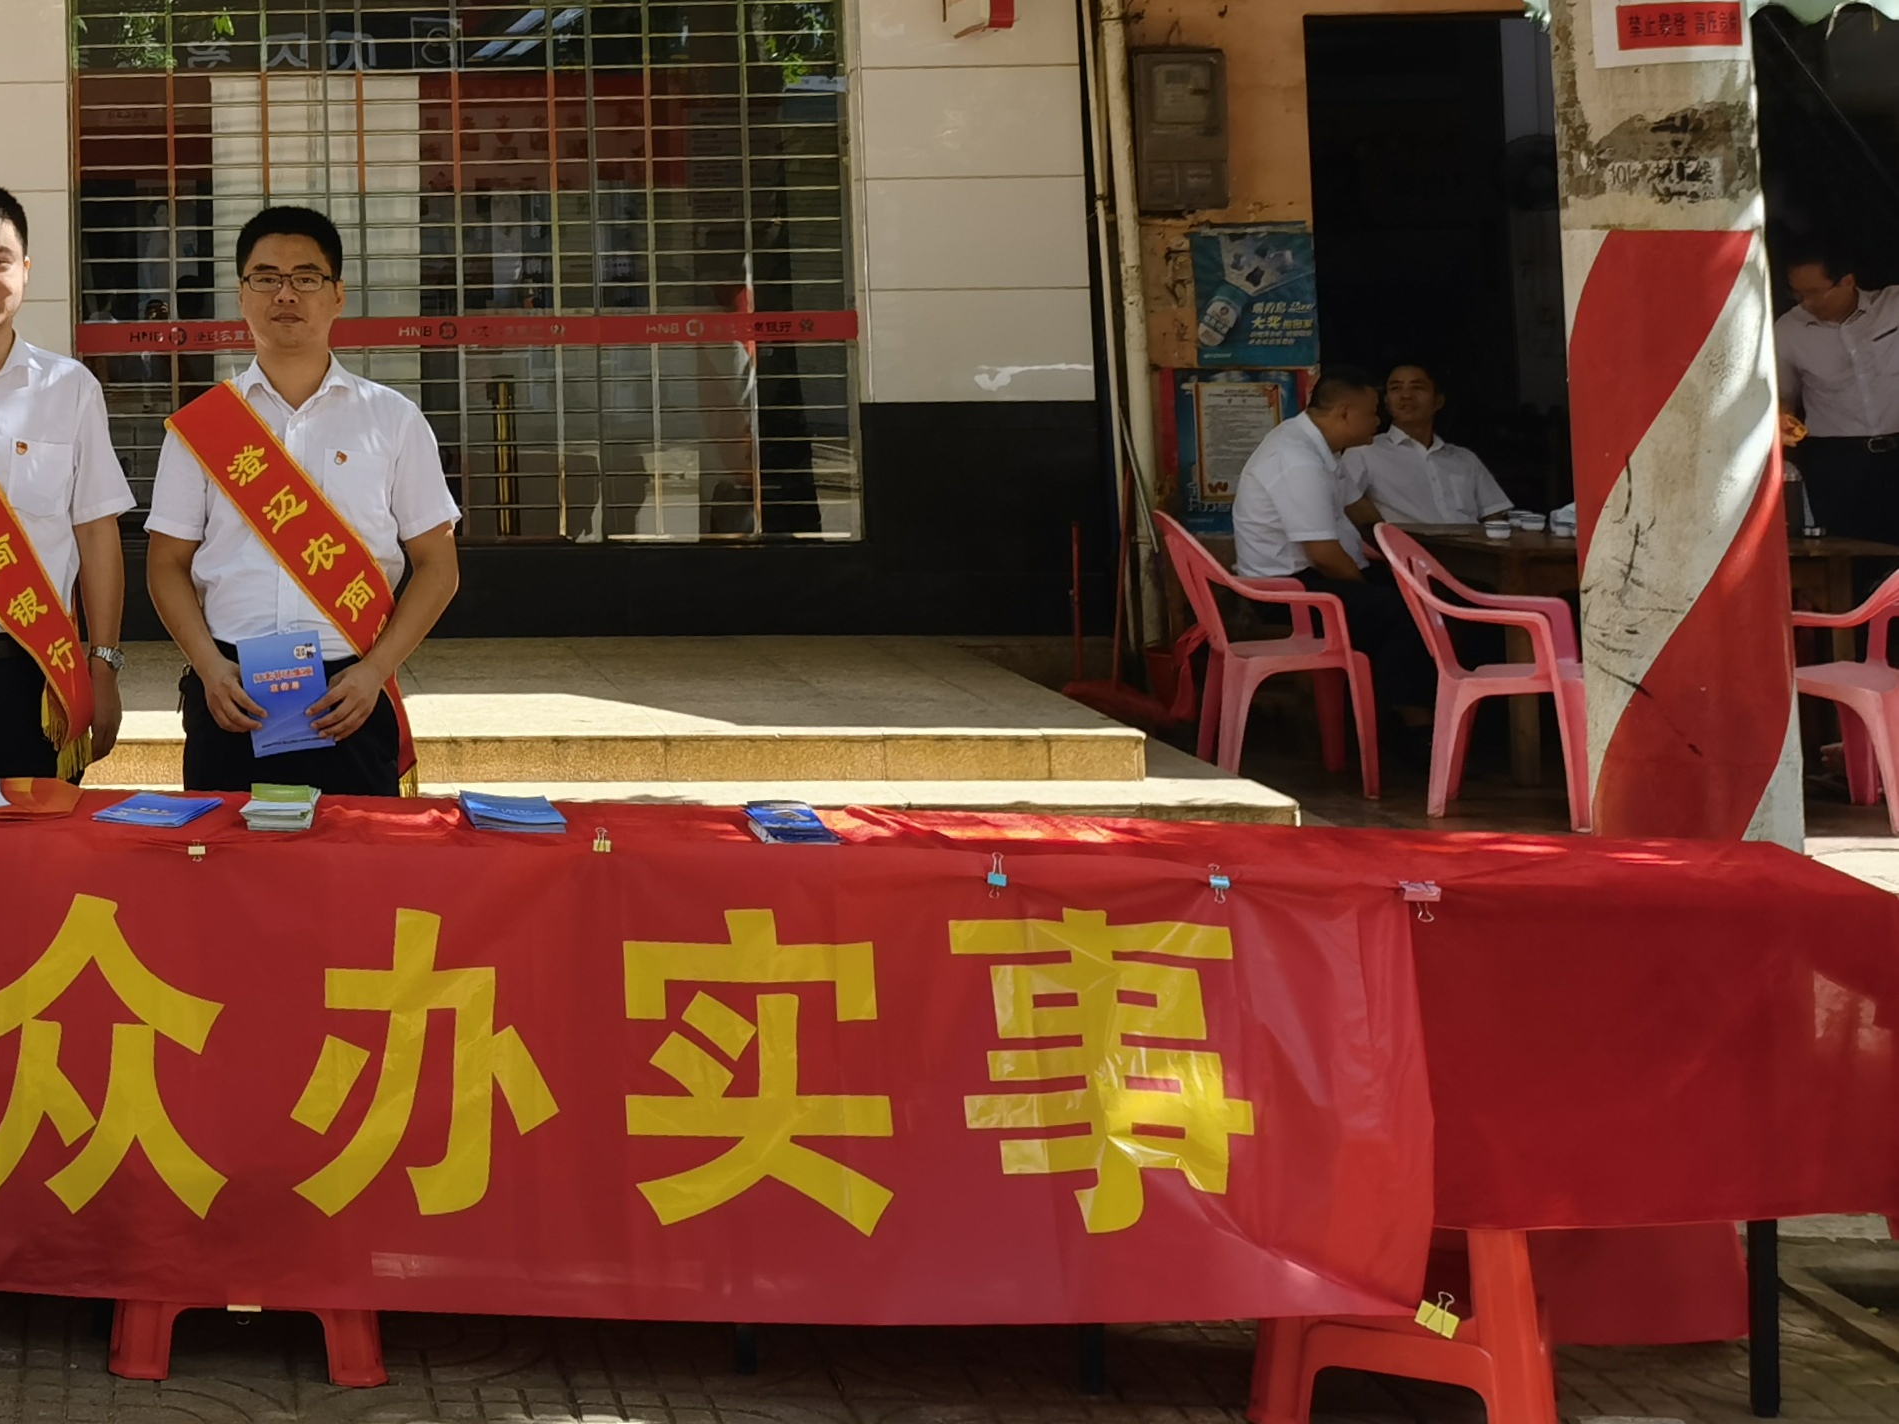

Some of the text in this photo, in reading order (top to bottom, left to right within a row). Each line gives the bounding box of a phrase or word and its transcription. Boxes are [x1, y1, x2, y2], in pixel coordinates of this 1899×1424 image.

[1628, 12, 1686, 37] 禁止攀登
[1251, 315, 1281, 329] 大奖
[398, 326, 432, 338] HNB
[226, 444, 388, 643] 澄迈农商
